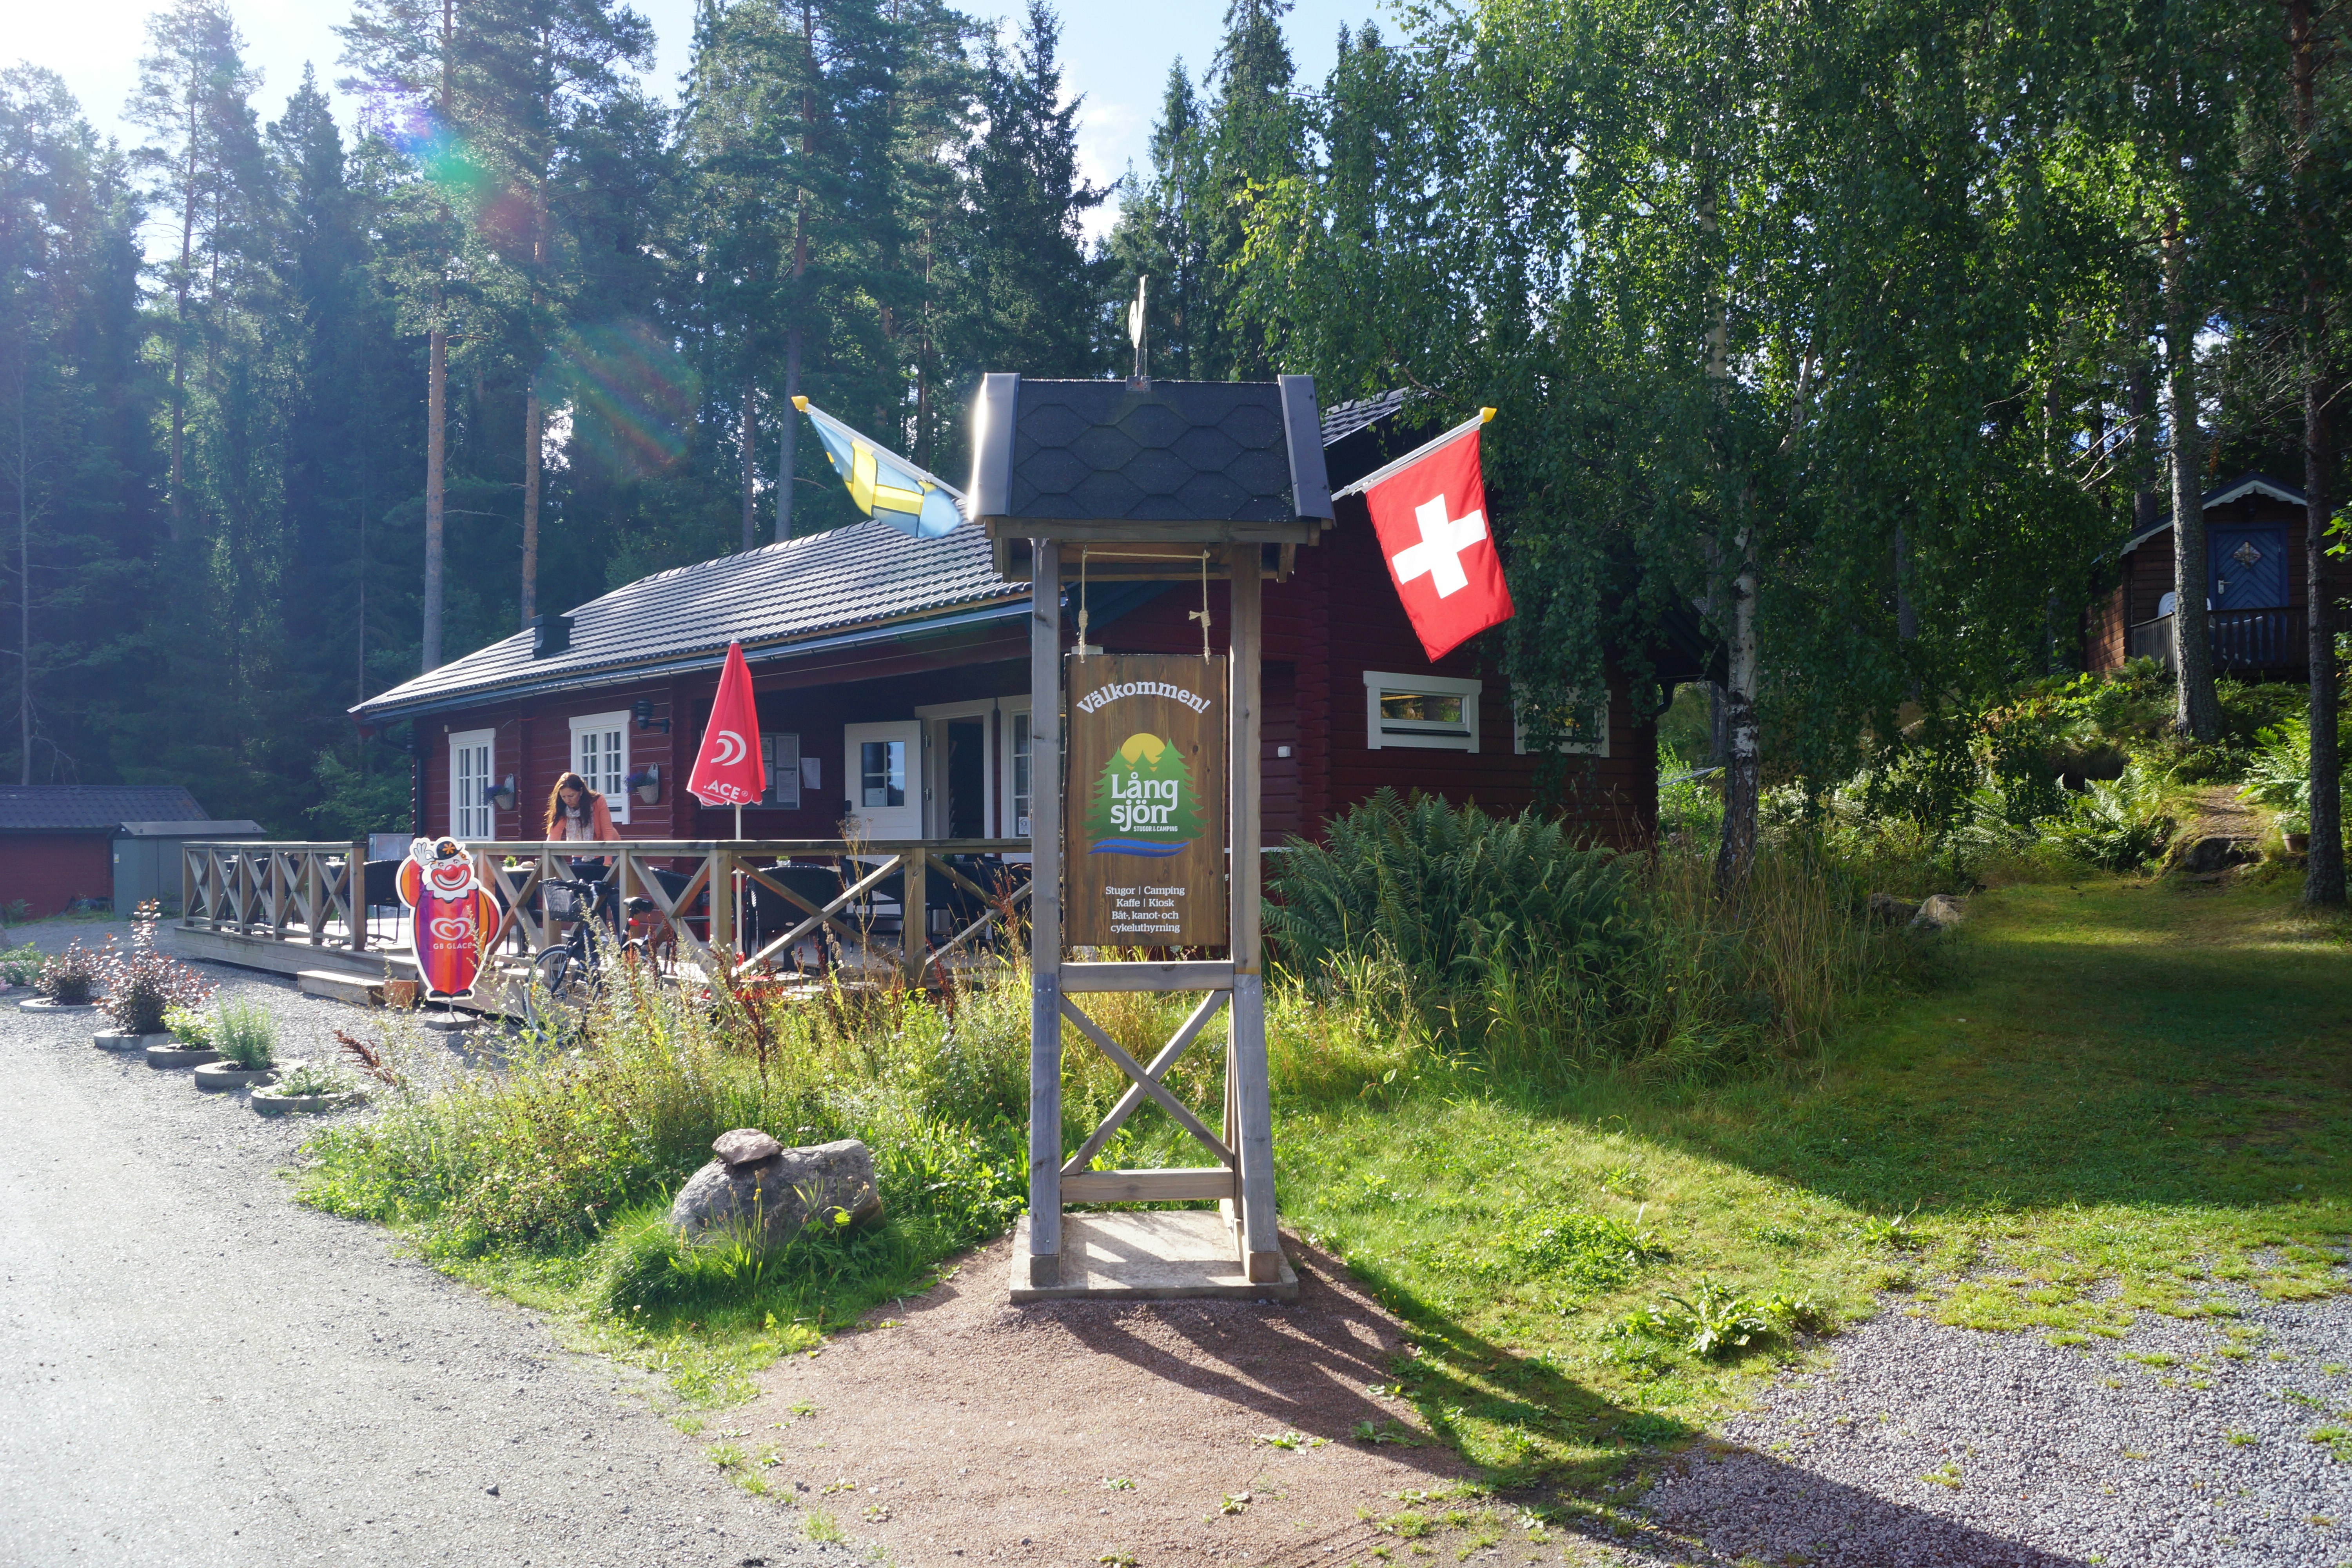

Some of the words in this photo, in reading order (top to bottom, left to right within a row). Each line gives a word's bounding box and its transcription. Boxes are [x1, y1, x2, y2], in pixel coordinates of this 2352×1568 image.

[1076, 681, 1210, 714] Välkommen!
[703, 779, 740, 800] ACE
[1111, 771, 1179, 811] Lång
[1111, 799, 1168, 831] sjön
[1105, 886, 1136, 896] Stugor
[1144, 886, 1185, 896] Camping
[1116, 898, 1140, 907] Kaffe
[1149, 898, 1174, 907] Kiosk
[1112, 910, 1130, 920] Båt-,
[1132, 911, 1160, 919] kanot-
[1111, 924, 1180, 933] cykeluthyrning
